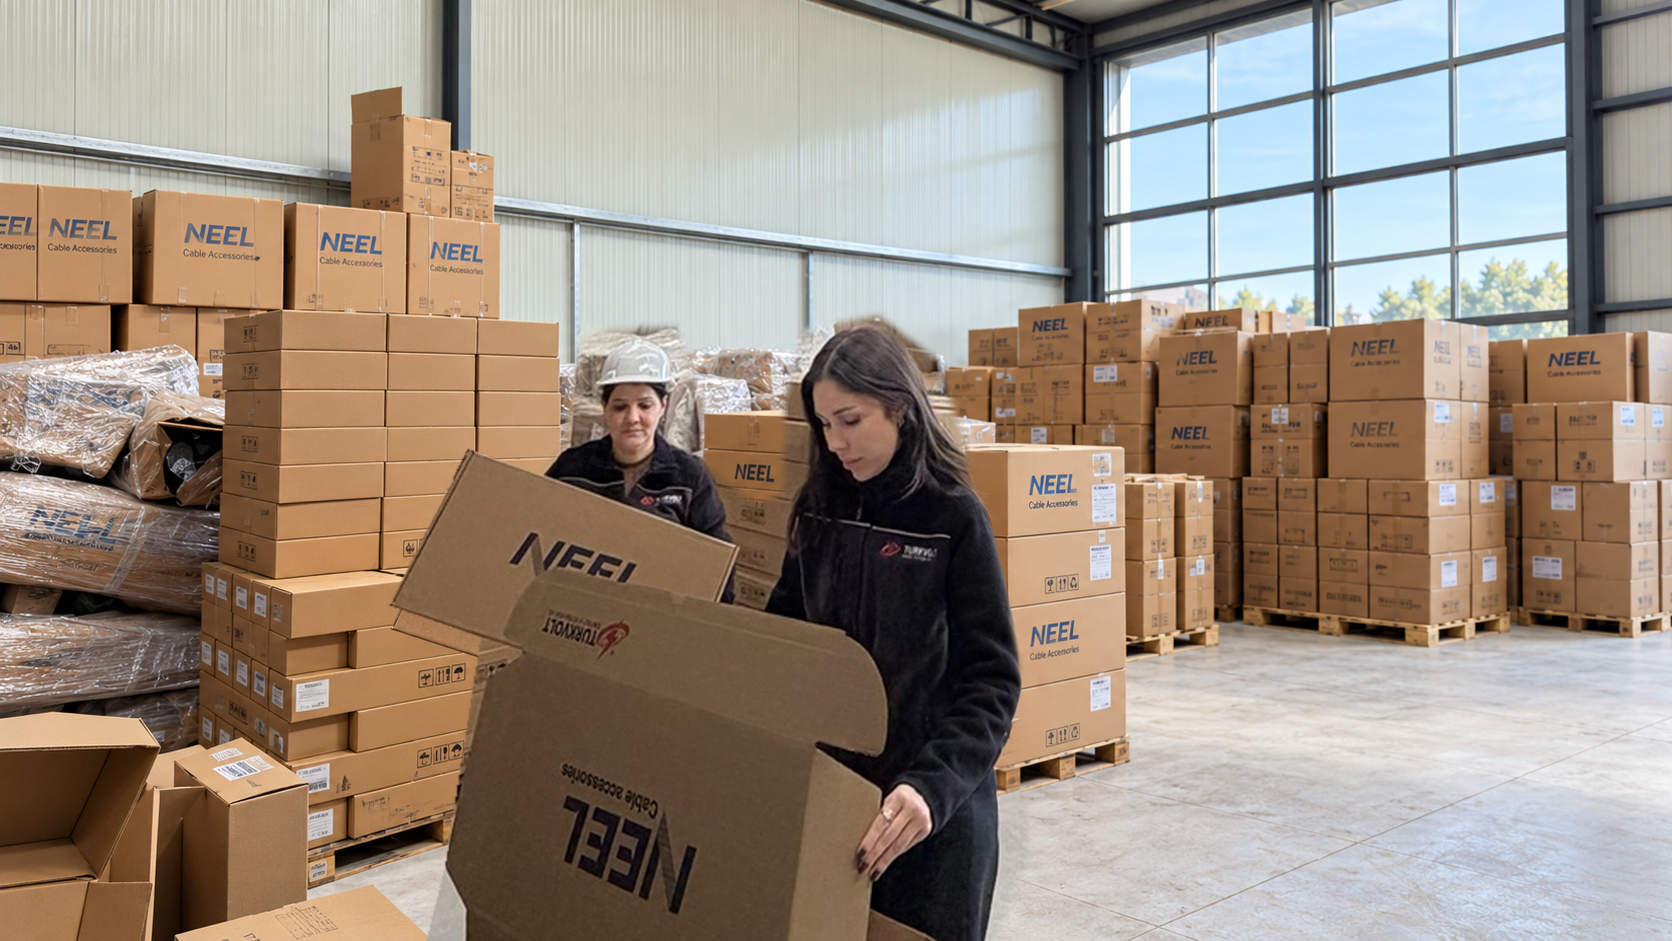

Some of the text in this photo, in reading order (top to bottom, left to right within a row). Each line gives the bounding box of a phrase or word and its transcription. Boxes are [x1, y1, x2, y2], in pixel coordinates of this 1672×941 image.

[48, 218, 117, 240] NEEL
[184, 223, 254, 247] NEEL
[48, 243, 117, 254] Cable Accessories
[320, 231, 383, 255] NEEL
[430, 241, 483, 263] NEEL
[183, 248, 254, 262] Cable Accessories
[319, 256, 341, 266] Cable
[429, 264, 448, 273] Cable
[1032, 317, 1069, 333] NEEL
[1195, 315, 1229, 328] NEEL
[1351, 338, 1400, 357] NEEL
[1176, 350, 1217, 367] NEEL
[1548, 350, 1601, 368] NEEL
[1171, 426, 1211, 440] NEEL
[1351, 421, 1400, 438] NEEL
[735, 463, 775, 483] NEEL
[1029, 473, 1077, 496] NEEL
[1029, 501, 1045, 510] Cable
[542, 617, 598, 647] TURKVOLT
[1030, 620, 1079, 647] NEEL
[1029, 651, 1046, 661] Cable
[561, 763, 659, 820] Cable accessories
[563, 795, 697, 915] NEEL
